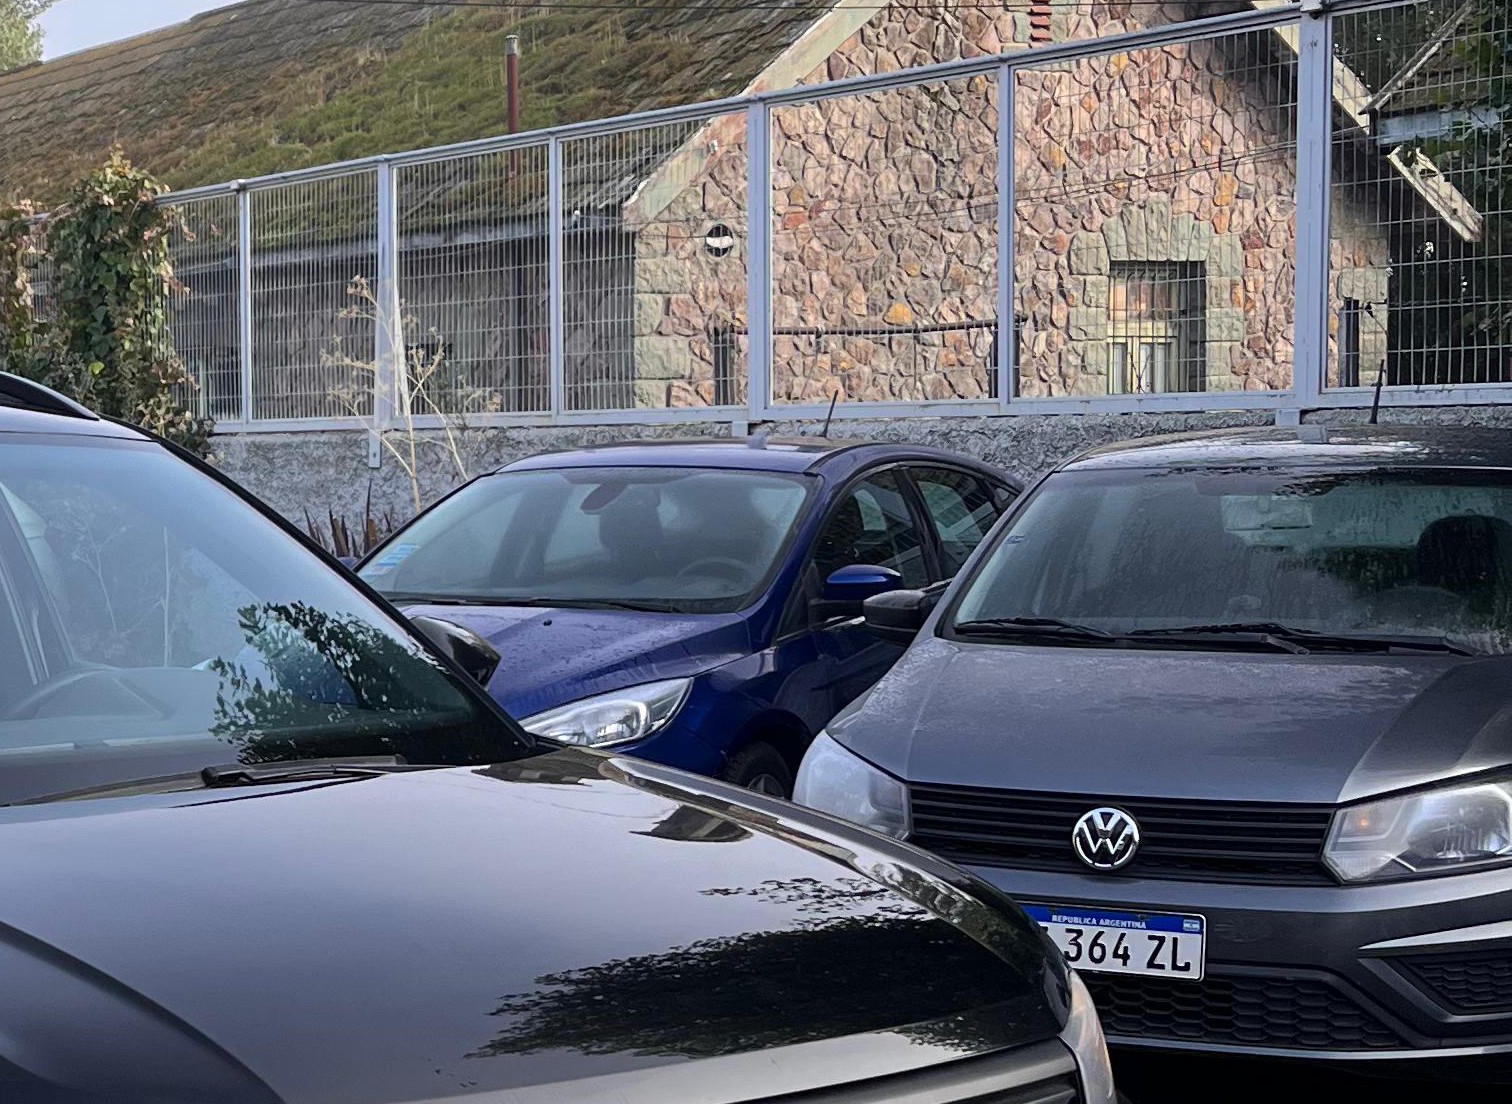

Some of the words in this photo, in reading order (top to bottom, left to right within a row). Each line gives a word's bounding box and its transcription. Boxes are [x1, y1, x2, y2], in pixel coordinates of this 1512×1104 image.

[1075, 808, 1138, 864] VW
[1099, 918, 1147, 929] ARGENTINA
[1064, 928, 1130, 966] 364
[1146, 935, 1191, 972] ZL
